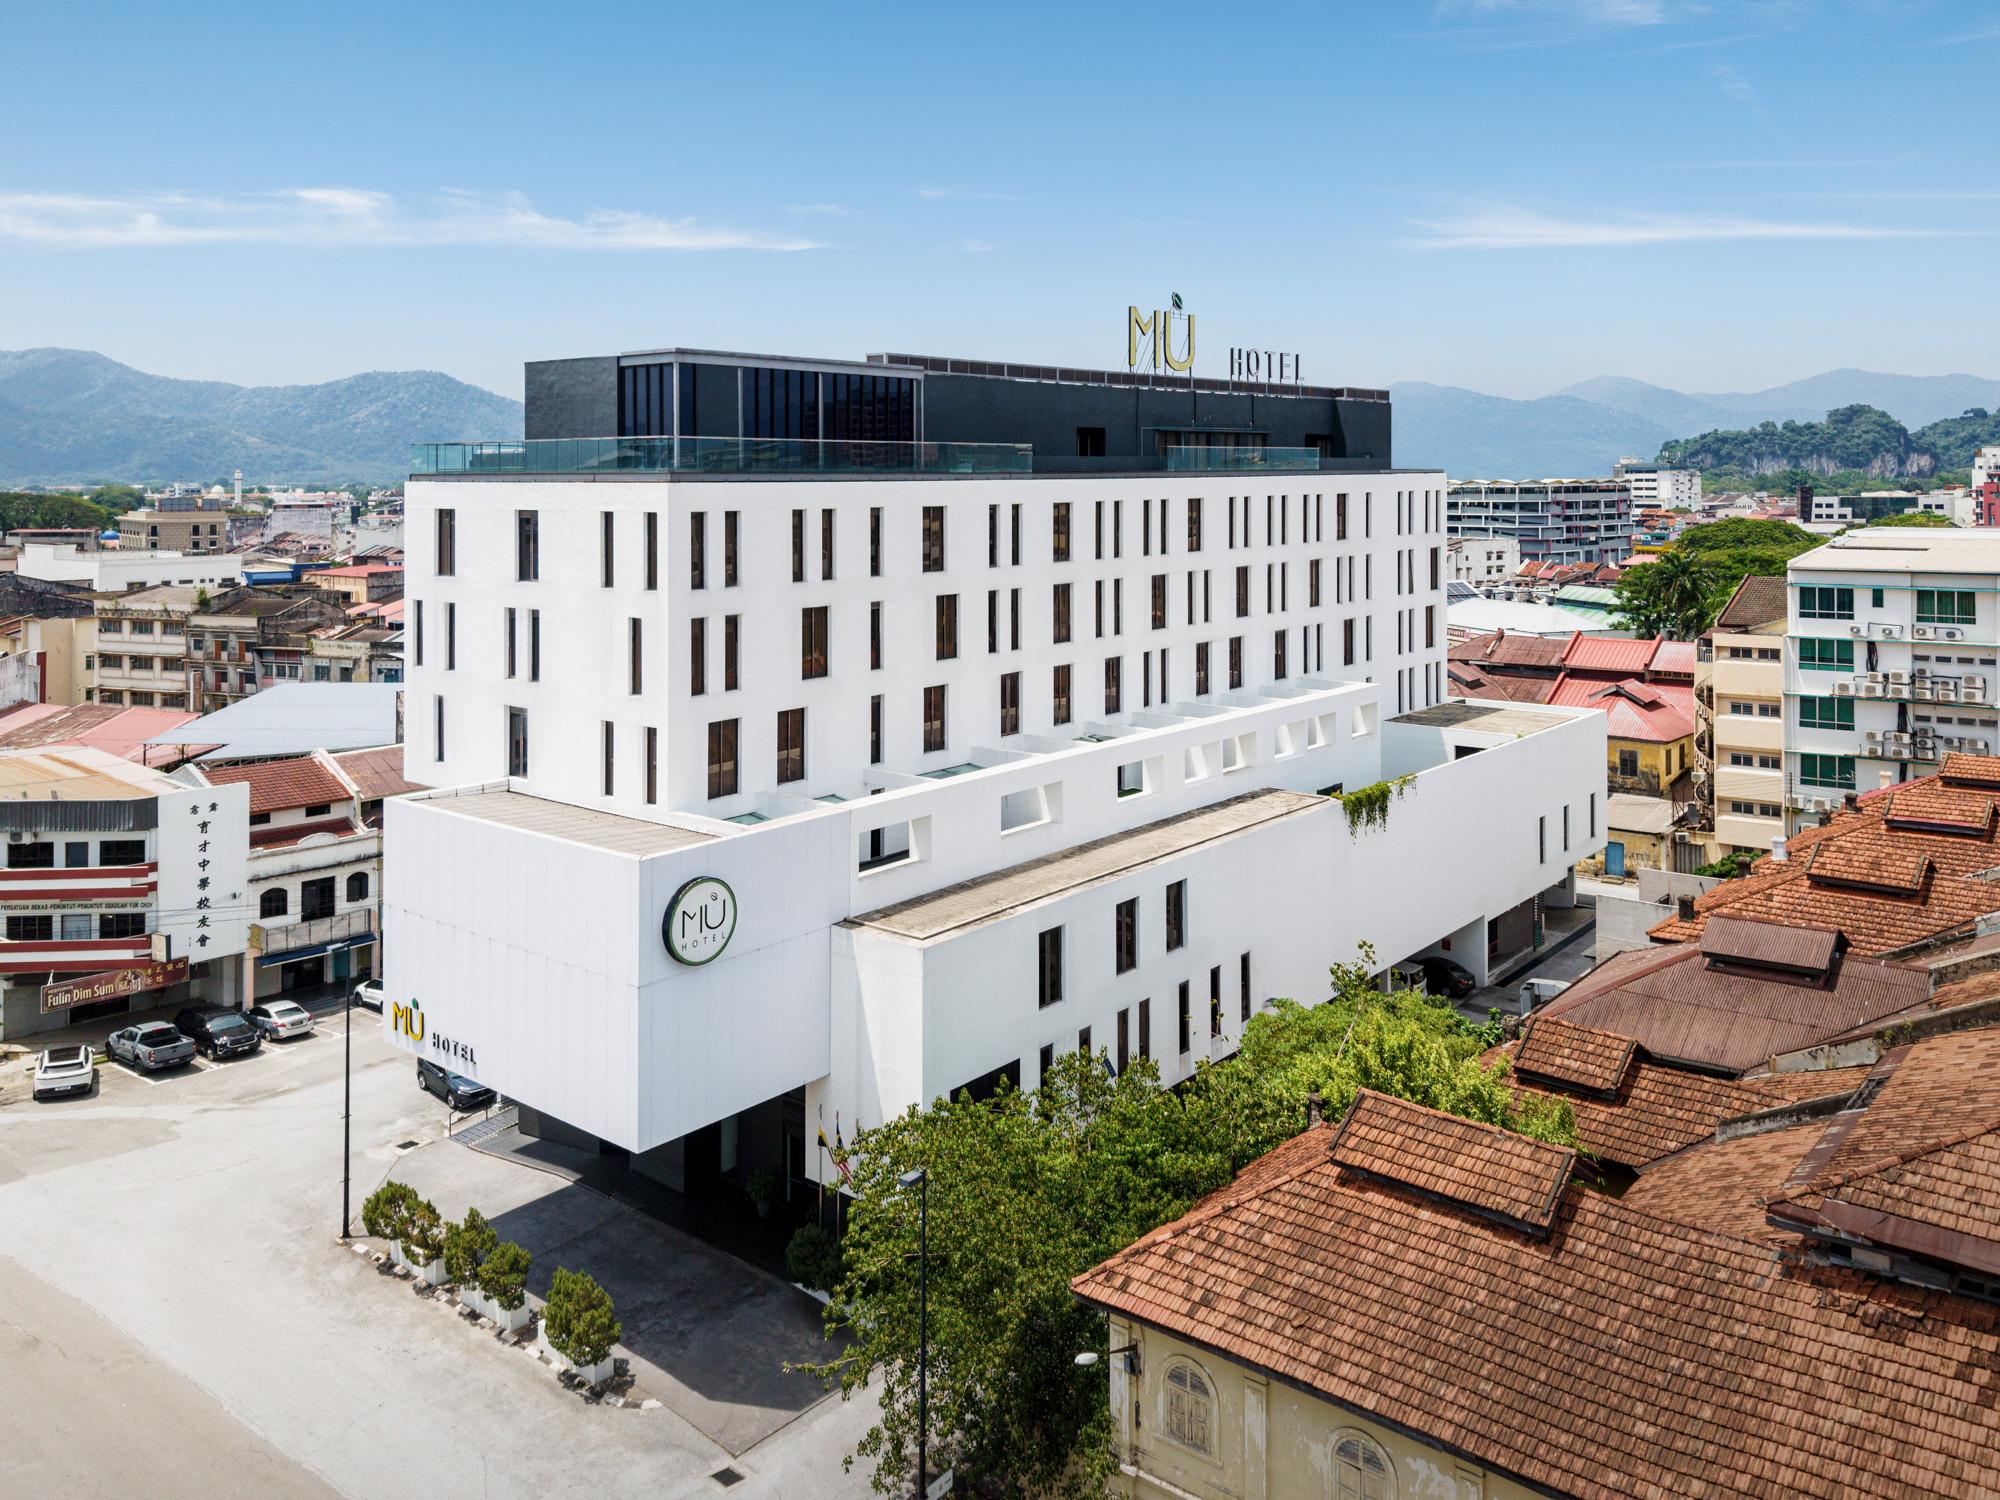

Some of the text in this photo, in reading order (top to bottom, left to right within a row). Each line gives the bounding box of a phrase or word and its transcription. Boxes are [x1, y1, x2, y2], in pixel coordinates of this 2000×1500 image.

[1230, 348, 1305, 382] HOTEL
[196, 820, 212, 947] 育才中學校友會
[681, 932, 726, 951] HOTEL
[48, 983, 114, 1008] Fulin Dim Sum
[432, 1032, 477, 1065] HOTEL
